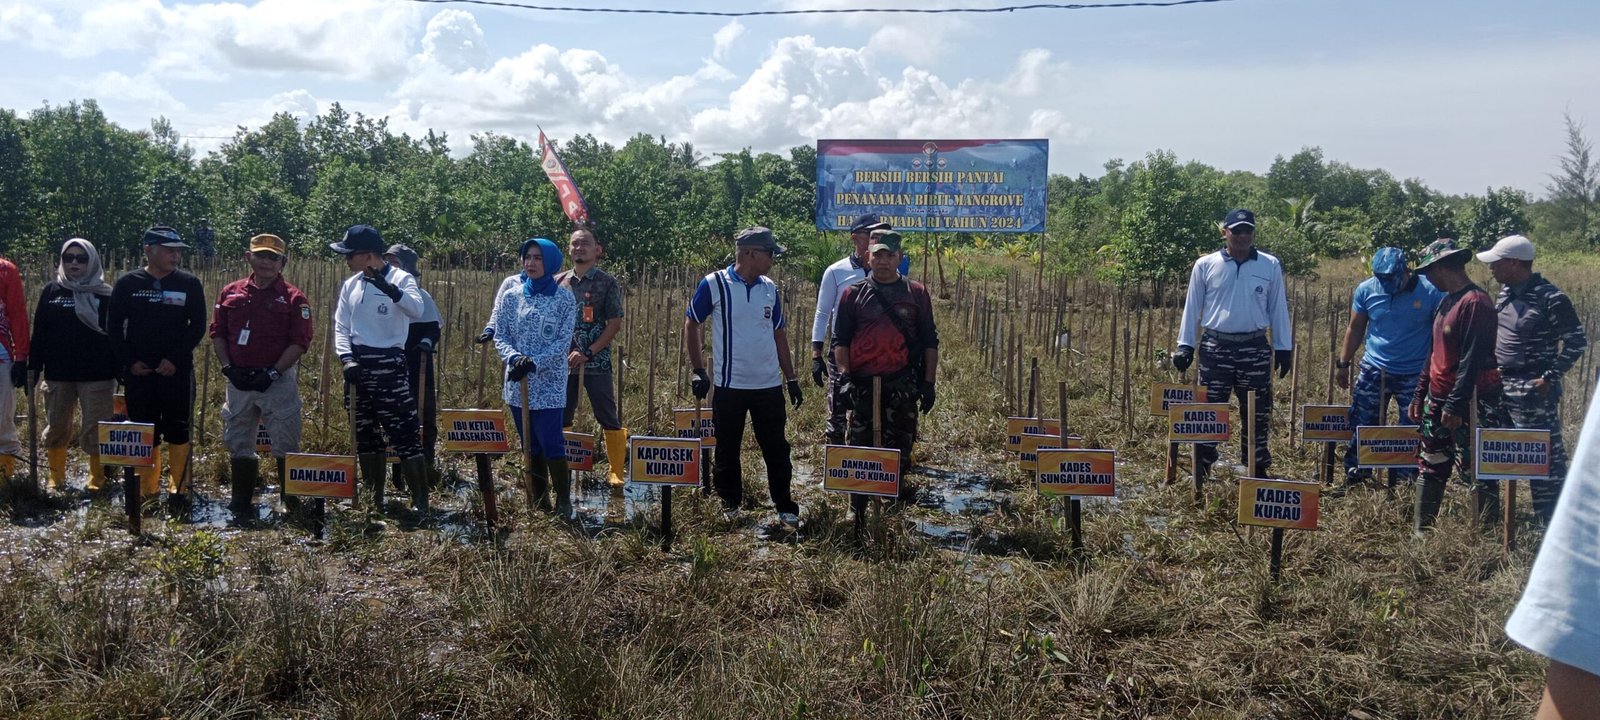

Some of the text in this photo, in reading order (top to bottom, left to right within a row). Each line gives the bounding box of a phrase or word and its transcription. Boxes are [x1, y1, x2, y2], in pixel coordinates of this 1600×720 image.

[855, 171, 1004, 184] BERSIH BERSIH PANTAI
[836, 193, 1024, 207] PENANAMAN BIBIT MANGROVE
[927, 215, 941, 228] RI
[943, 215, 988, 228] TAHUN
[991, 216, 1022, 229] 2024
[1184, 411, 1216, 422] KADES
[1322, 415, 1345, 423] KADES
[452, 420, 495, 431] IBU KETUA
[1174, 423, 1226, 434] SERIKANDI
[109, 430, 142, 444] BUPATI
[447, 430, 504, 442] JALASENASTRI
[99, 443, 153, 458] TANAH LAUT
[1483, 441, 1546, 453] BABINSA DESA
[637, 447, 694, 462] KAPOLSEK
[1482, 452, 1547, 465] SUNGAI BAKAU
[646, 462, 684, 476] KURAU
[841, 459, 883, 471] DANRAMIL
[1060, 462, 1091, 473] KADES
[289, 468, 347, 483] DANLANAL
[828, 469, 849, 480] 1009
[855, 470, 867, 481] 05
[868, 471, 896, 483] KURAU
[1040, 474, 1111, 485] SUNGAI BAKAU
[1256, 487, 1301, 506] KADES
[1253, 504, 1301, 521] KURAU
